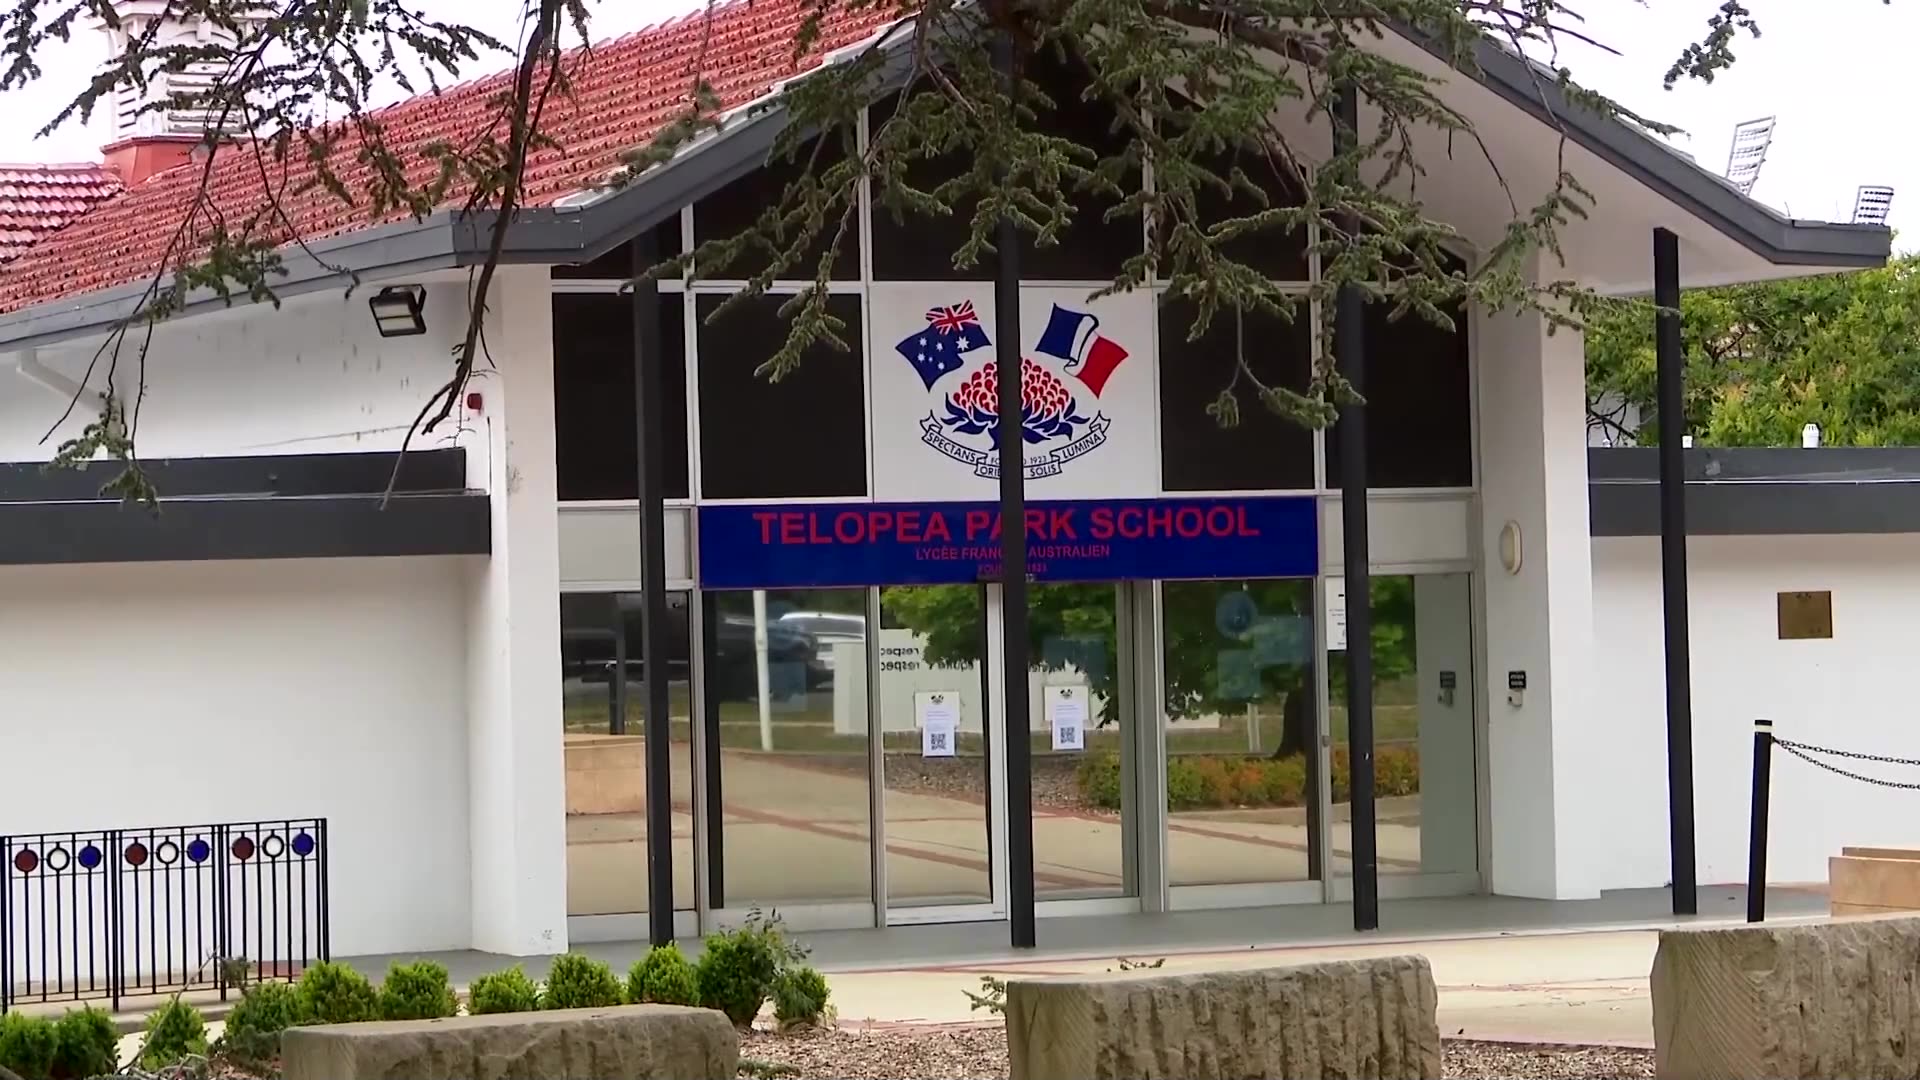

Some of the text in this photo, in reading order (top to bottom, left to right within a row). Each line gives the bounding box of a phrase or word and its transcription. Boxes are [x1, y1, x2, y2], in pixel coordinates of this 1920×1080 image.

[927, 432, 976, 462] SPECTANS
[1030, 464, 1057, 477] SOLIS
[1062, 433, 1102, 459] LUMINA
[752, 511, 951, 545] TELOPEA
[1090, 505, 1262, 540] SCHOOL
